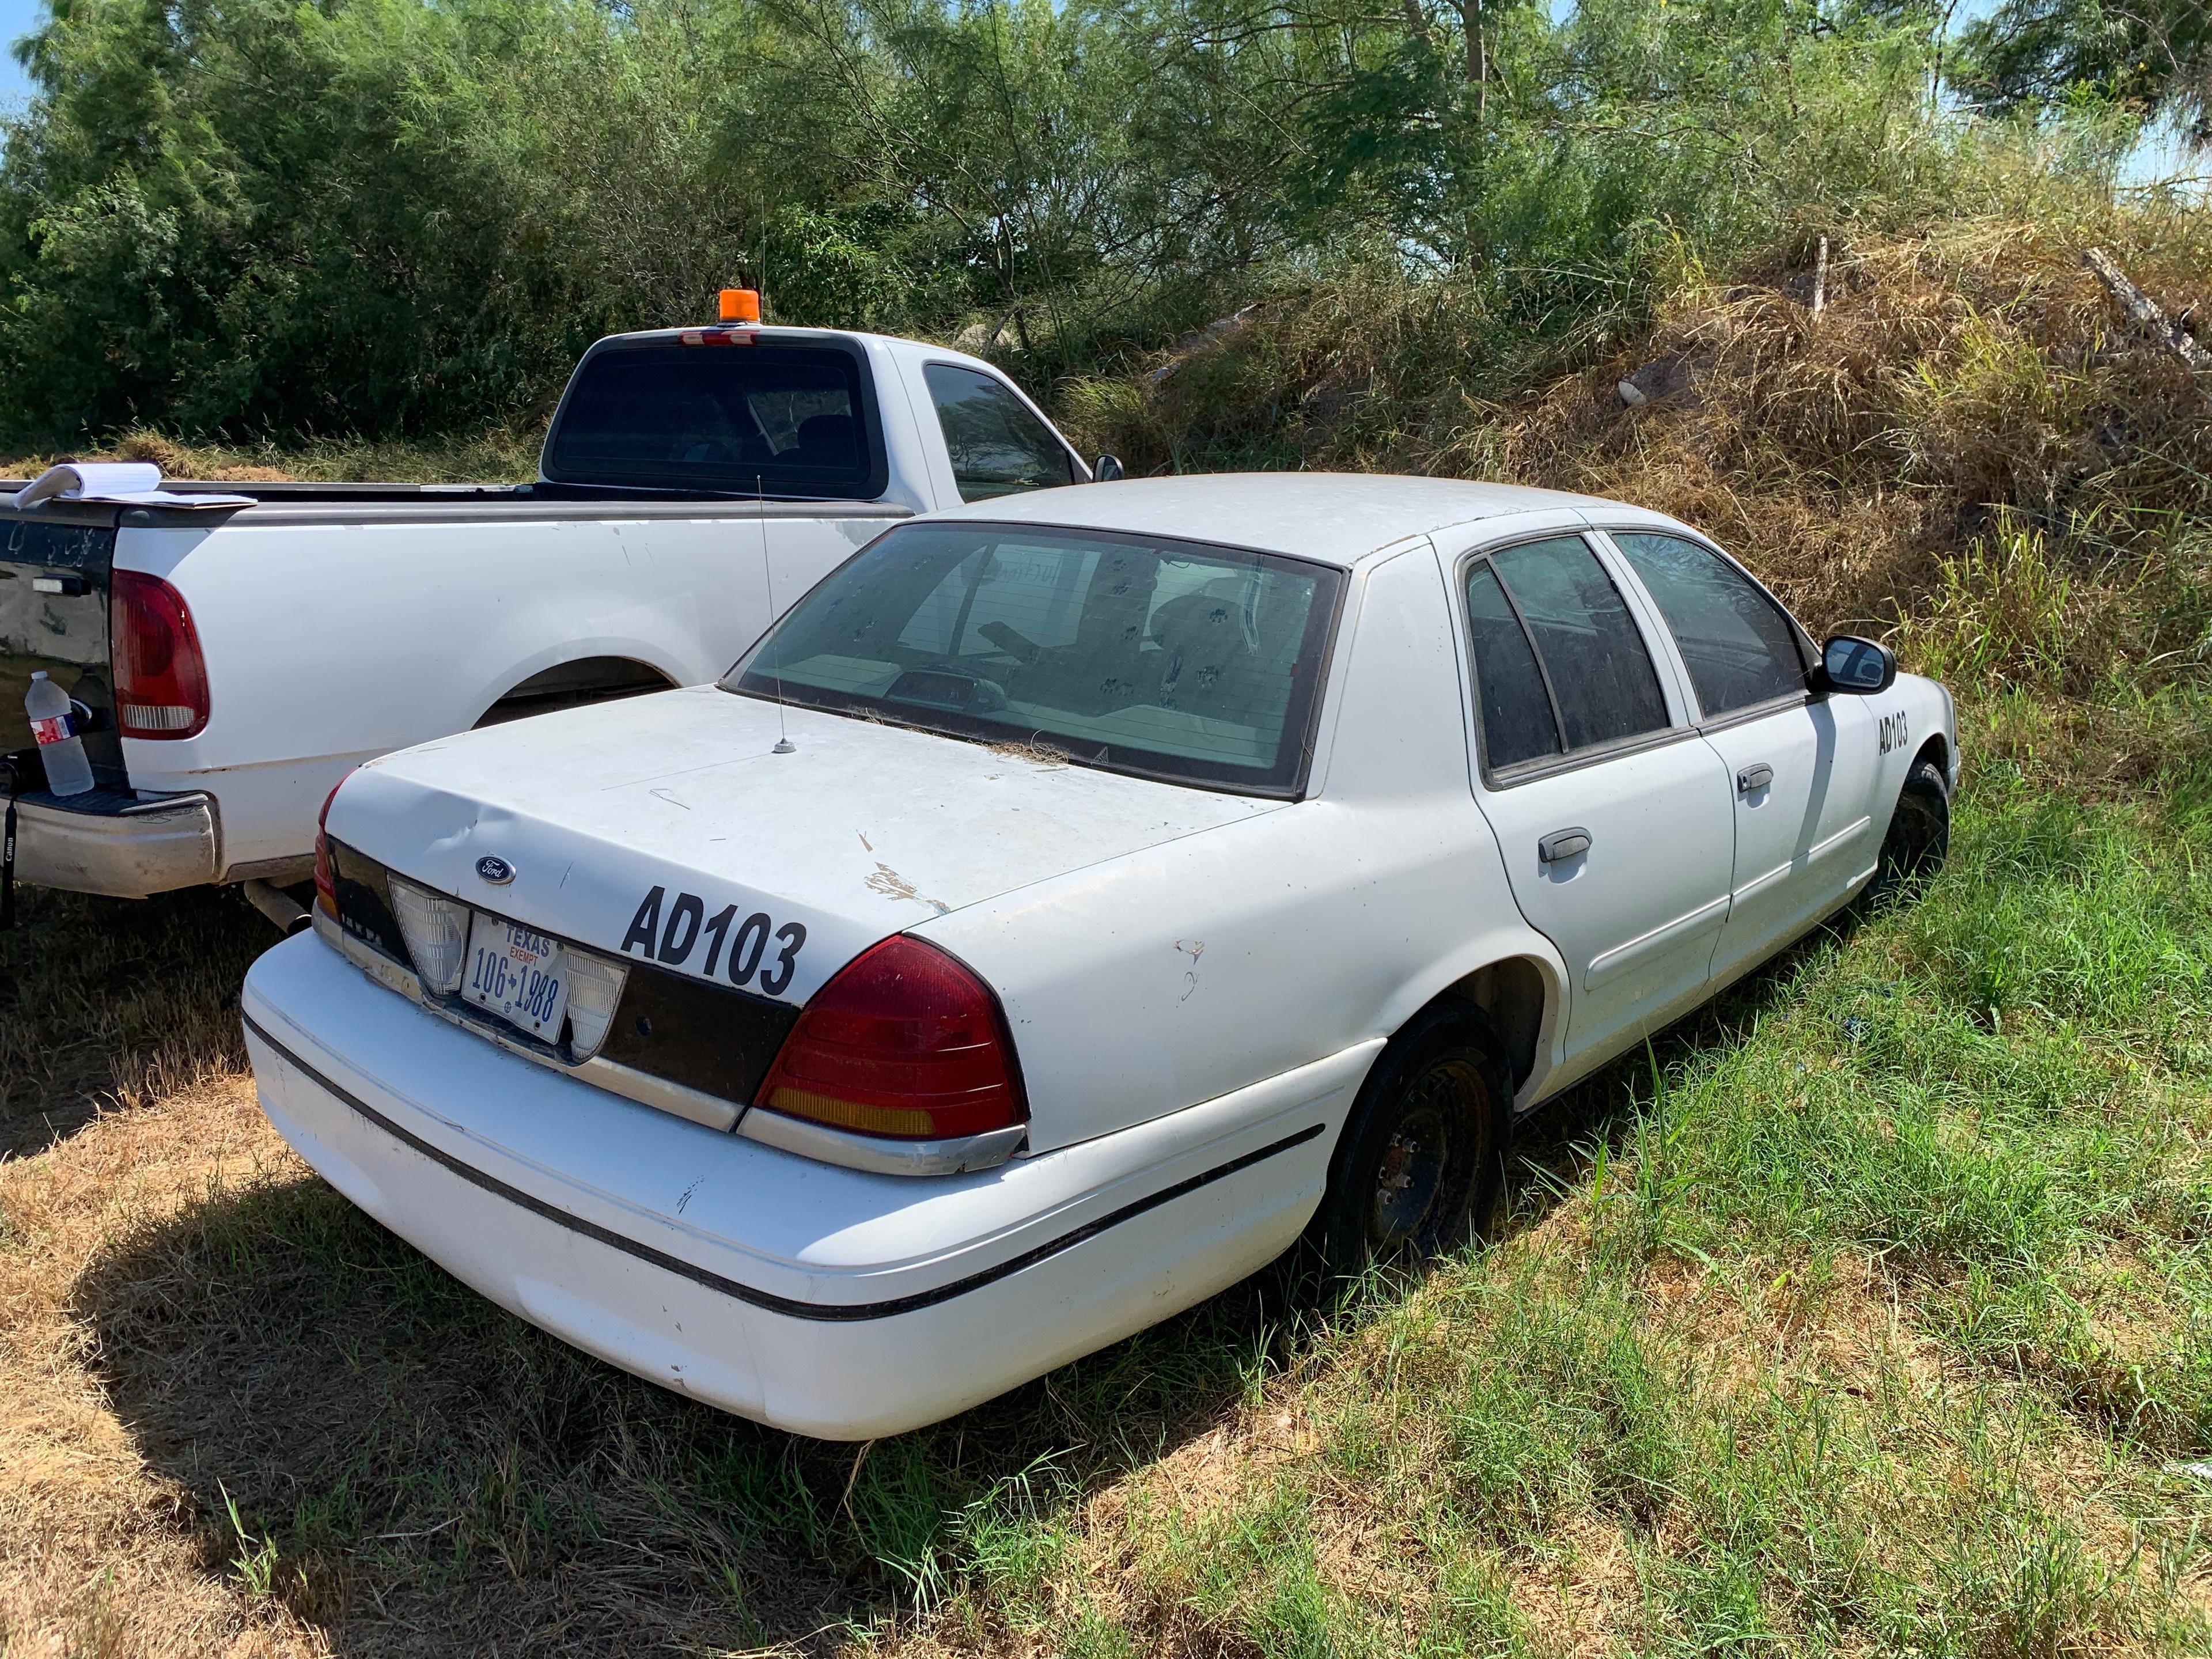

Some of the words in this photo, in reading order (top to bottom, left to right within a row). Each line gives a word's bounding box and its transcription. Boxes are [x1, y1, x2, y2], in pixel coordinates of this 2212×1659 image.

[1879, 710, 1907, 756] AD103
[482, 860, 503, 877] Ford
[506, 924, 550, 957] TEXAS
[510, 946, 538, 966] EXEMPT
[620, 885, 806, 995] AD103
